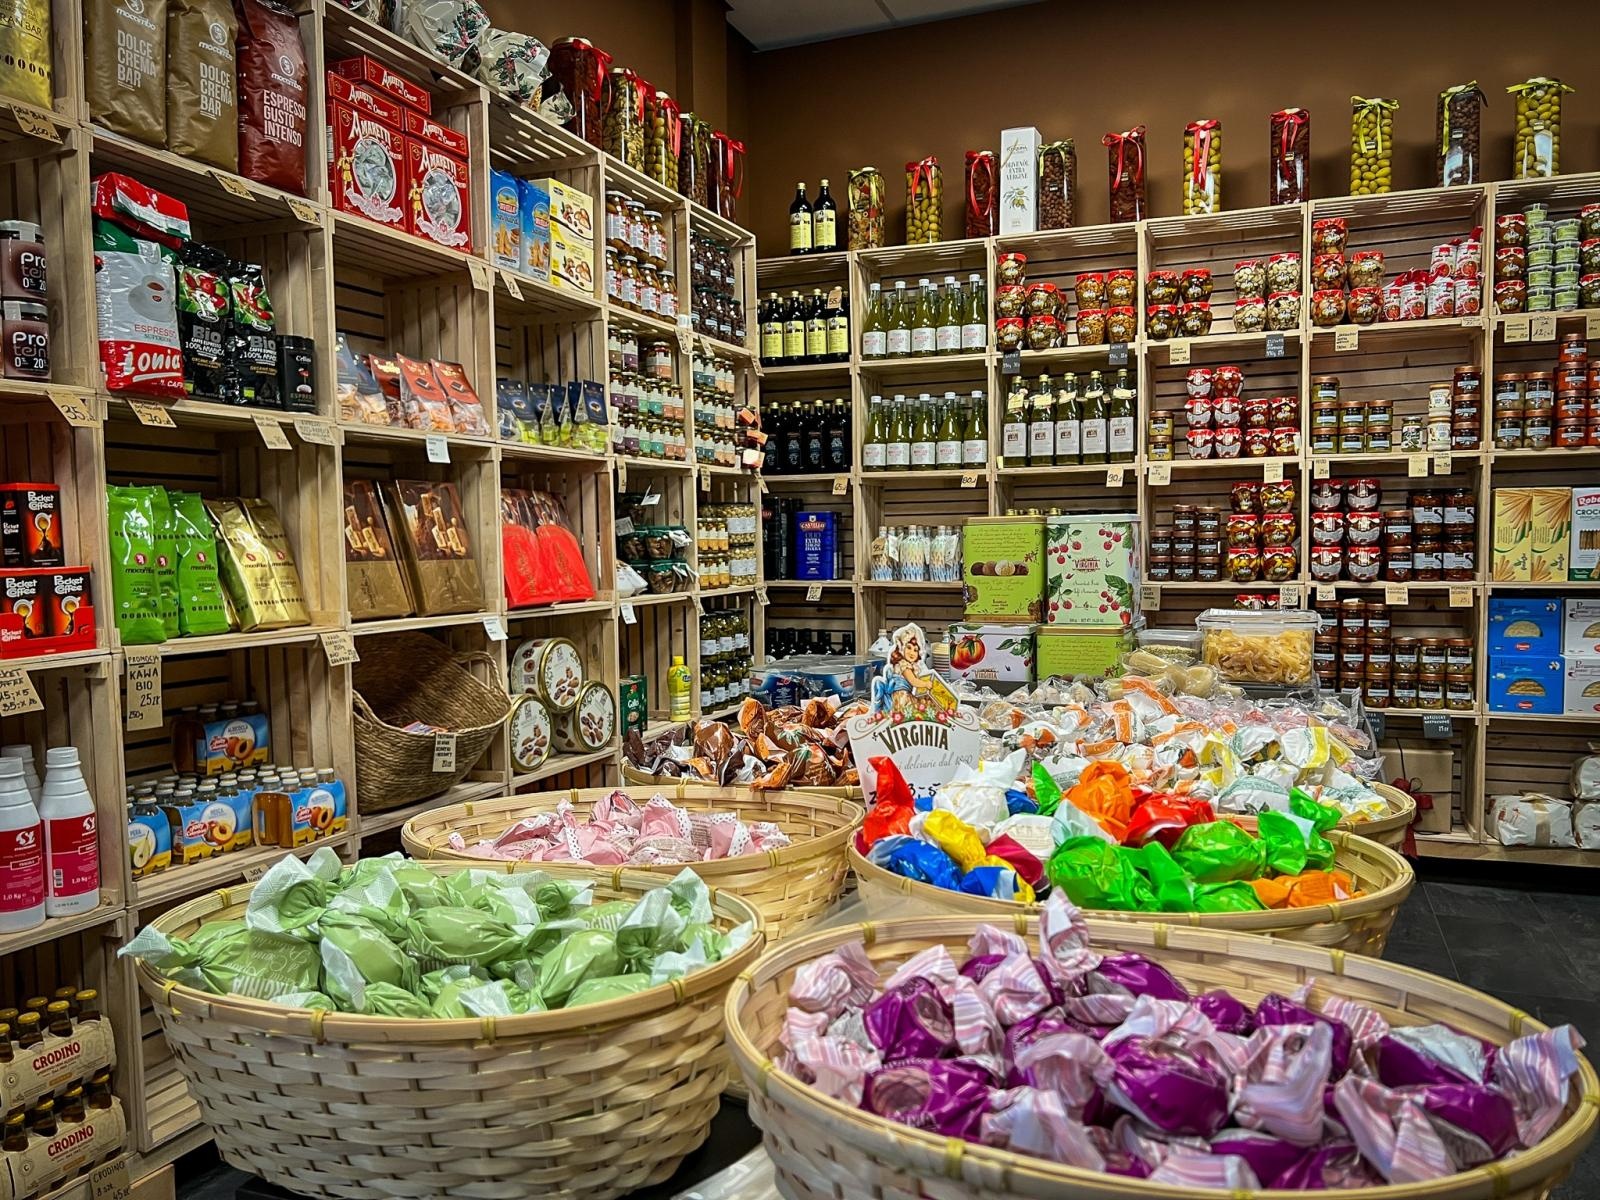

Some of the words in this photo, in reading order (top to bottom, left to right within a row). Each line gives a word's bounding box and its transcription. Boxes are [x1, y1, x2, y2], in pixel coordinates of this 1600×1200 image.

[25, 22, 42, 37] BAR
[117, 28, 153, 56] DOLCE
[117, 49, 157, 79] CREMA
[200, 62, 231, 87] DOLCE
[117, 66, 142, 89] BAR
[200, 81, 233, 107] CREMA
[200, 98, 222, 117] BAR
[263, 90, 306, 121] ESPRESSO
[263, 106, 295, 129] GUSTO
[264, 121, 302, 148] INTENSO
[192, 324, 222, 344] Bio
[250, 335, 276, 351] Bio
[28, 491, 54, 503] Pocket
[28, 499, 54, 511] Coffee
[5, 577, 38, 589] Pocket
[54, 575, 84, 587] Pocket
[54, 583, 83, 595] Coffee
[6, 587, 37, 598] Coffee
[129, 667, 159, 680] KAWA
[135, 681, 153, 691] BIO
[878, 724, 949, 755] VIRGINIA
[33, 1042, 81, 1071] CRODINO
[48, 1125, 95, 1157] CRODINO
[94, 1160, 125, 1183] CRODINO
